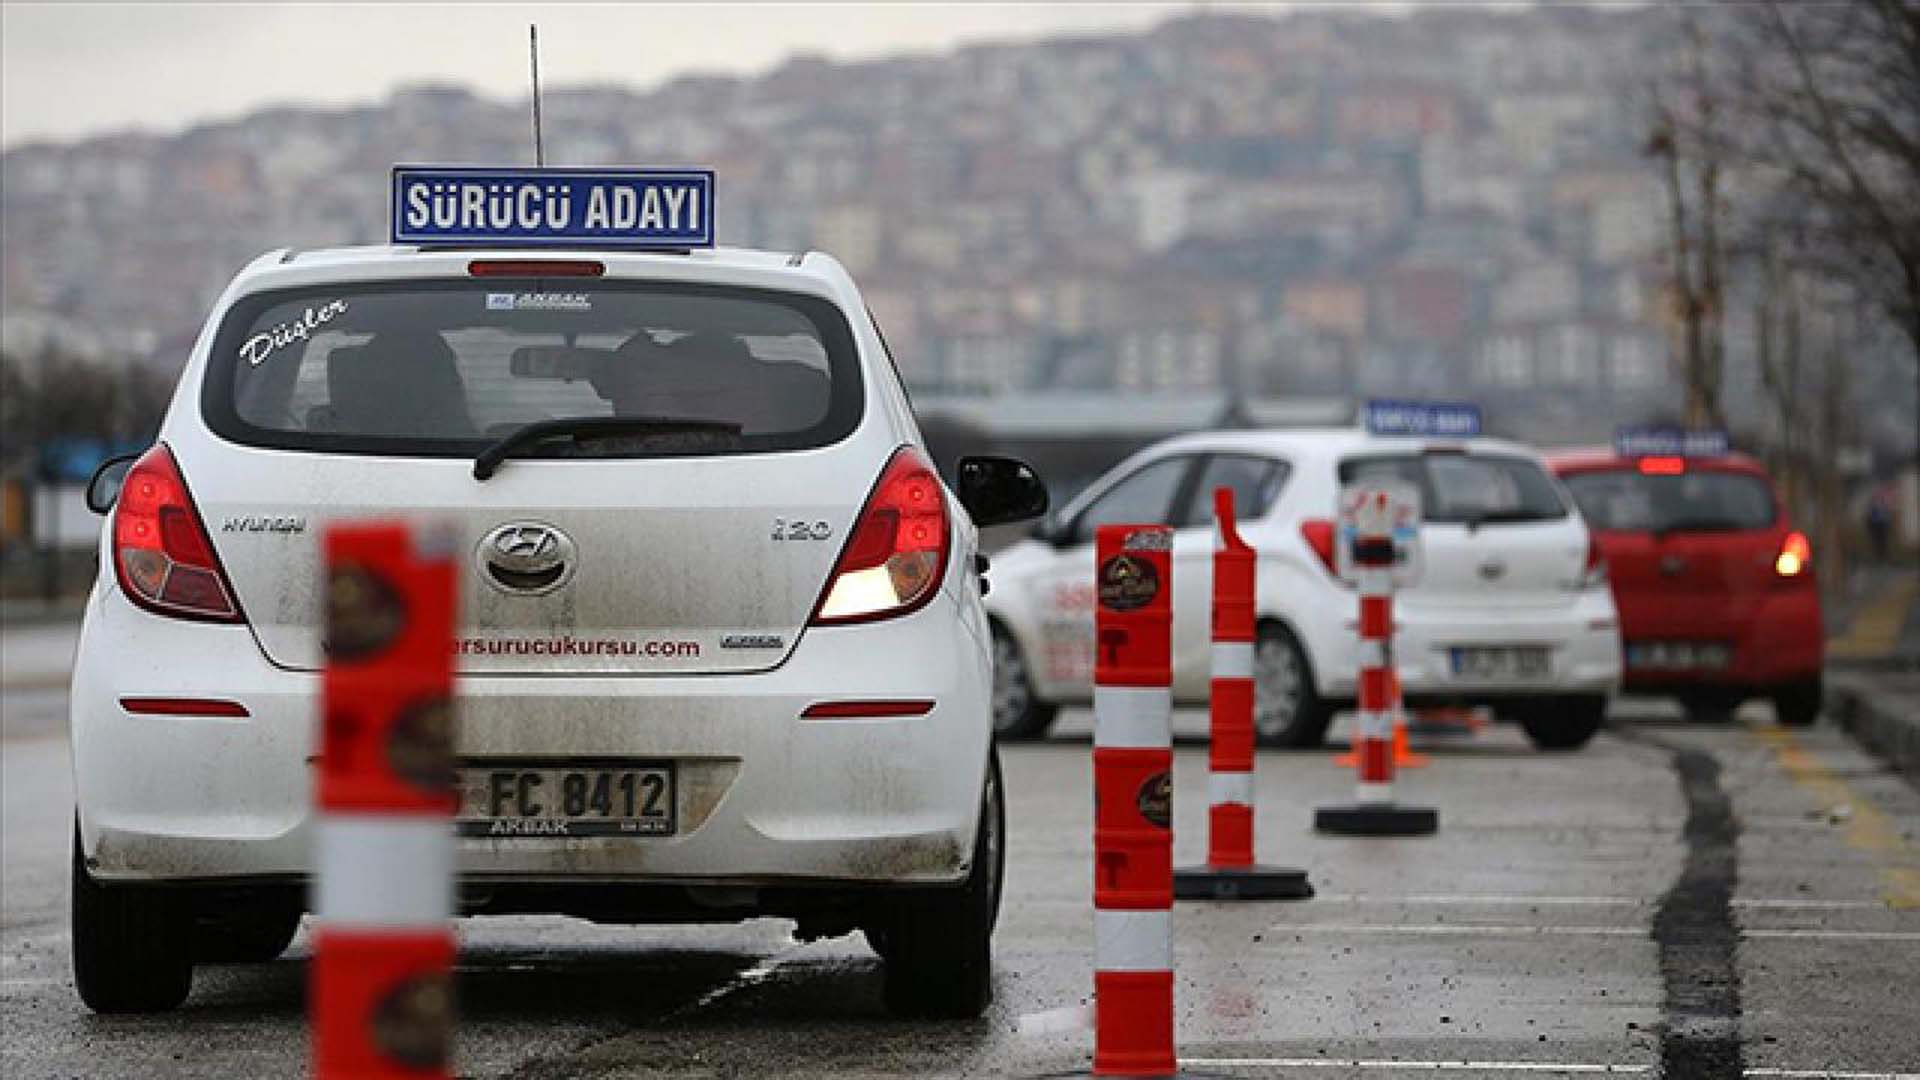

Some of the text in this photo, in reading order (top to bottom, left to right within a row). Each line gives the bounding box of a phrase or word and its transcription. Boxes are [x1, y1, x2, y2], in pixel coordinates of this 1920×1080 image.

[407, 182, 698, 229] SÜRÜCÜ ADAYI
[770, 518, 832, 541] i20
[491, 772, 543, 817] FC
